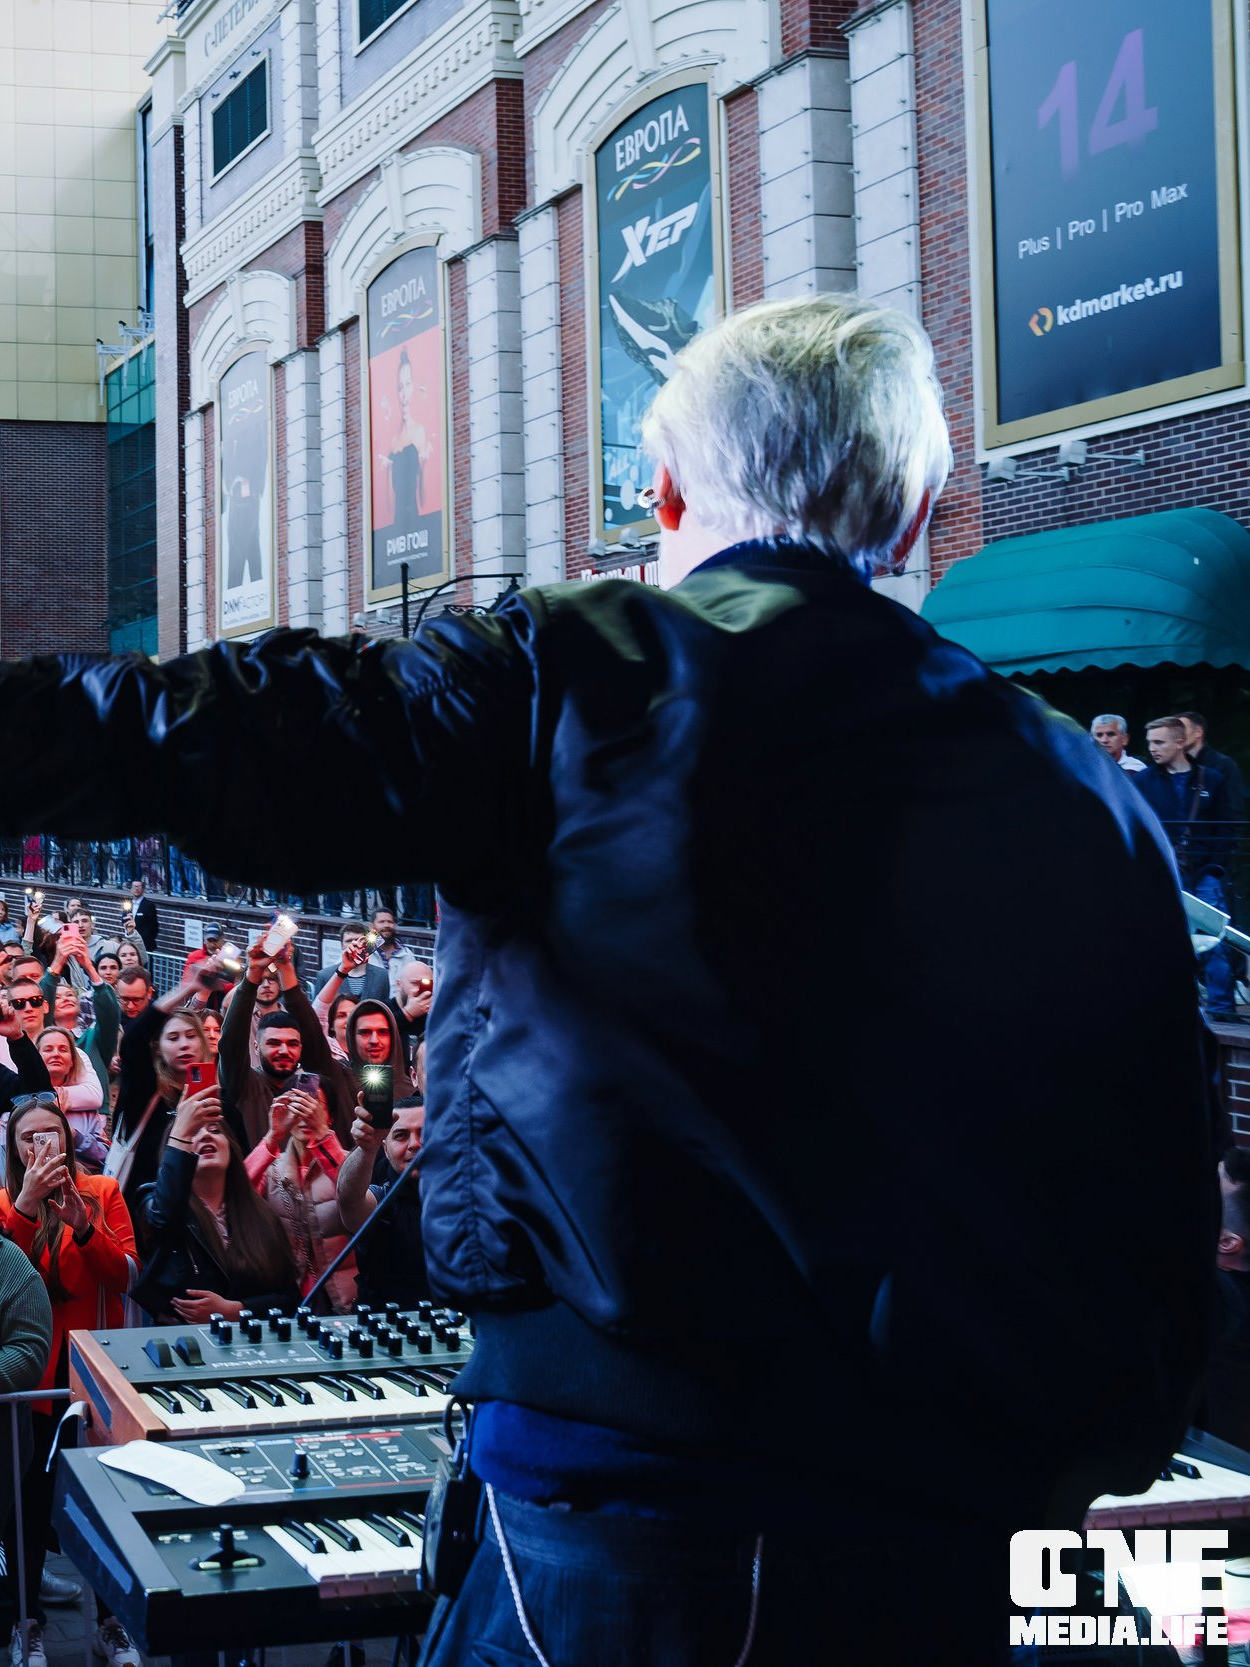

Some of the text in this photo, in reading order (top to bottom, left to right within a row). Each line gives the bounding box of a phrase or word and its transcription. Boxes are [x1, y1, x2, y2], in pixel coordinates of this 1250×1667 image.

[1037, 28, 1158, 179] 14
[615, 104, 690, 172] ЕВРОПА
[1017, 234, 1050, 260] Plus
[1067, 217, 1096, 241] Pro
[1114, 199, 1144, 223] Pro
[1151, 181, 1189, 210] Max
[381, 275, 426, 317] ЕВРОПА
[1056, 269, 1183, 326] kdmarket.ru
